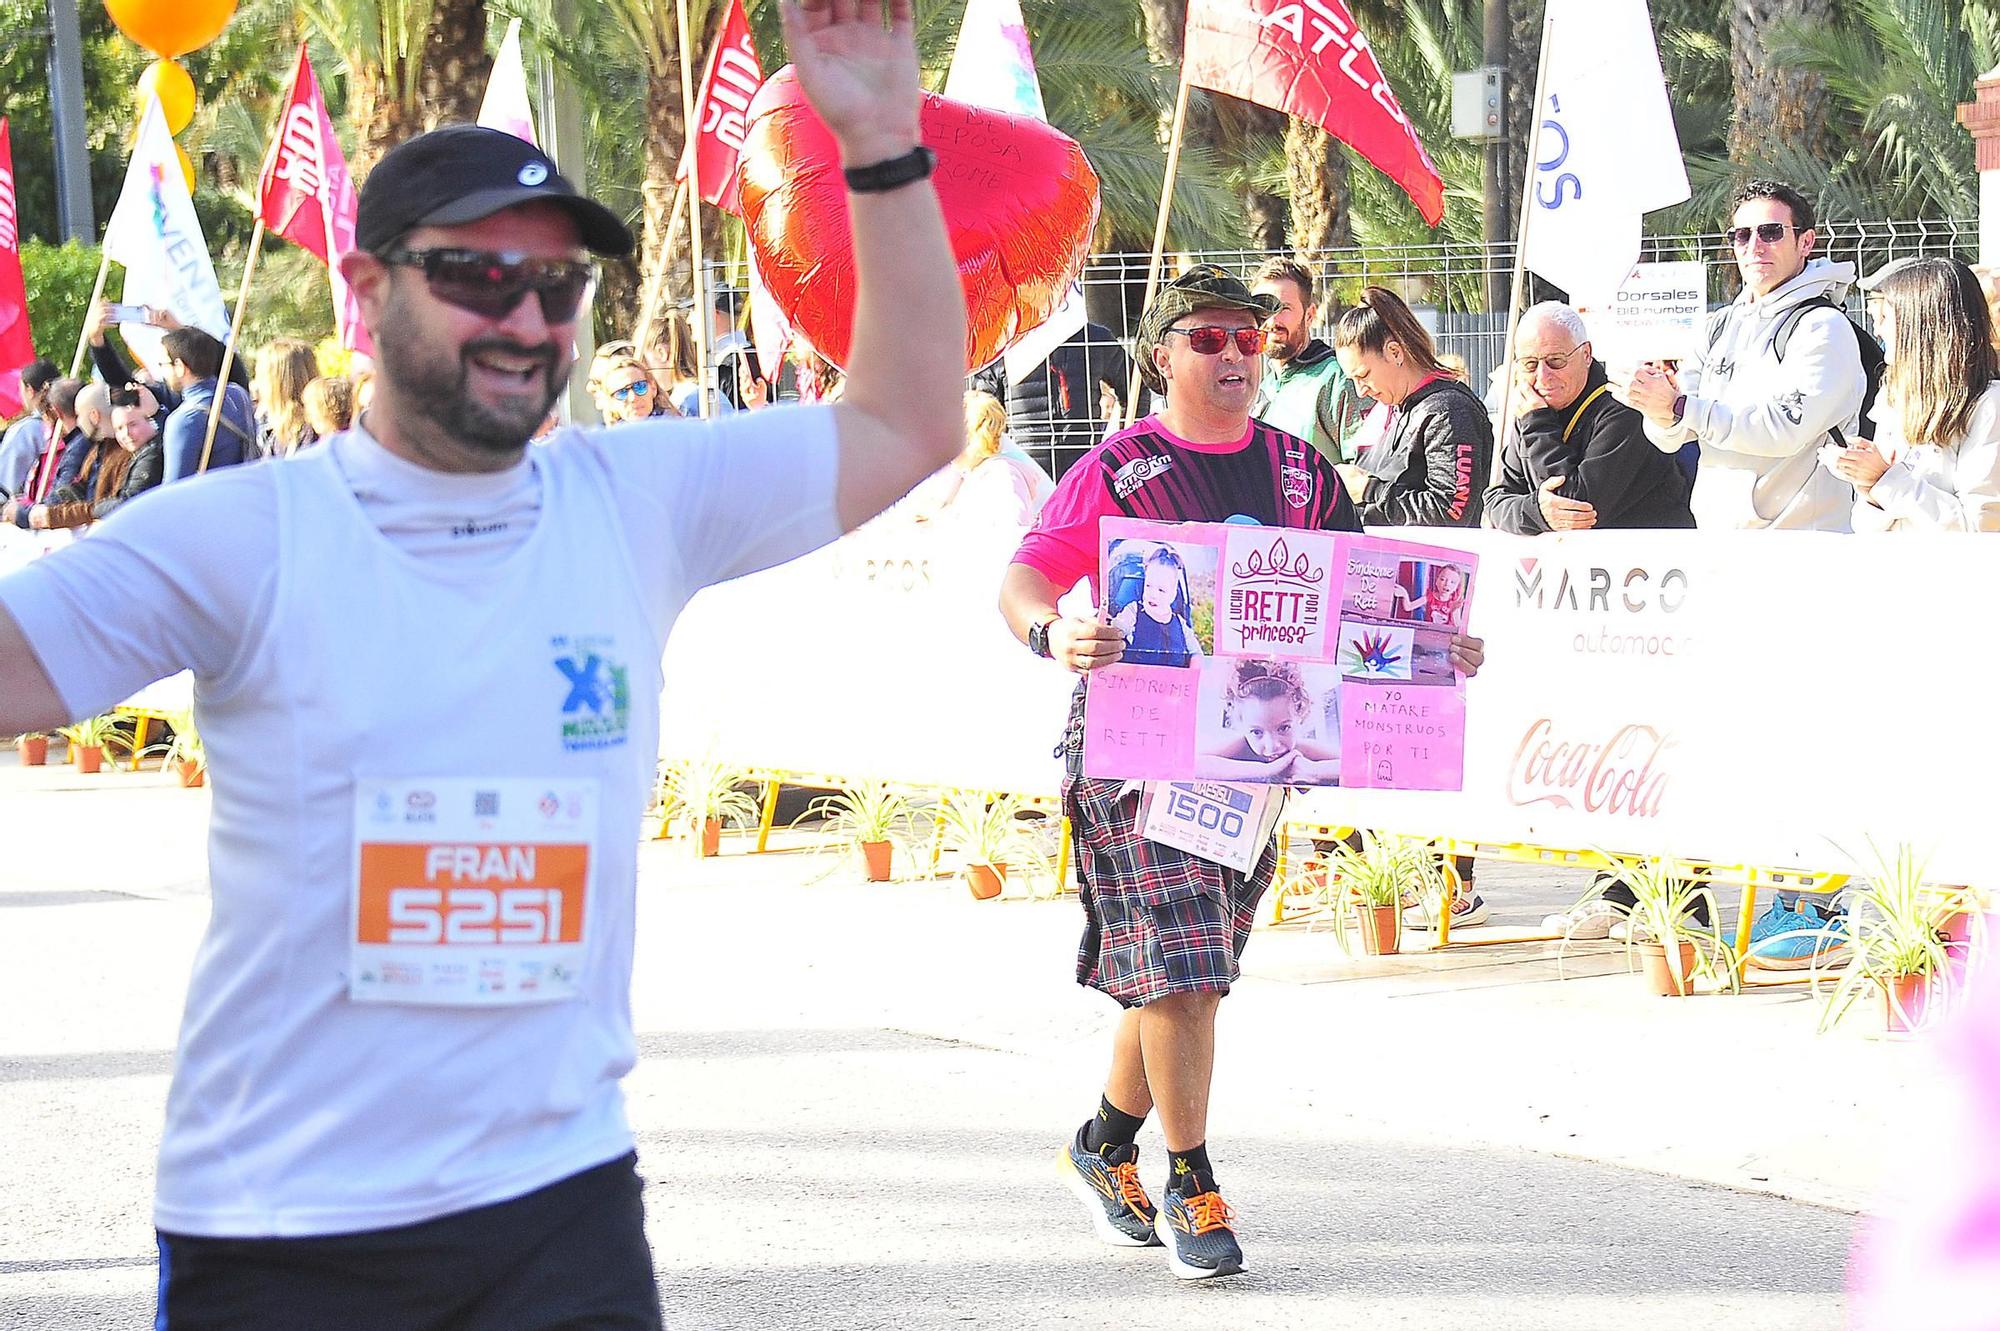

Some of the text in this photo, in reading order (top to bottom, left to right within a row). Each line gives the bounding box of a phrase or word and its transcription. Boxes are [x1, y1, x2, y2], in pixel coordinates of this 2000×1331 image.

[1617, 289, 1698, 302] Dorsales
[1616, 305, 1700, 316] BIB number
[1446, 444, 1473, 521] LUANVI
[1361, 578, 1376, 593] De
[1229, 589, 1244, 620] LUCHA
[1244, 590, 1304, 623] RETT
[1303, 594, 1320, 625] POR TI
[1240, 620, 1307, 649] princesa
[1097, 670, 1192, 697] SINDROME
[1385, 690, 1402, 701] YO
[1131, 705, 1160, 721] DE
[1364, 702, 1431, 718] MATARE
[1104, 728, 1168, 748] RETT
[1355, 719, 1447, 738] MONSTRUOS
[1363, 741, 1429, 760] POR TI
[1167, 790, 1244, 838] 1500
[425, 846, 537, 883] FRAN
[387, 887, 564, 943] 5251
